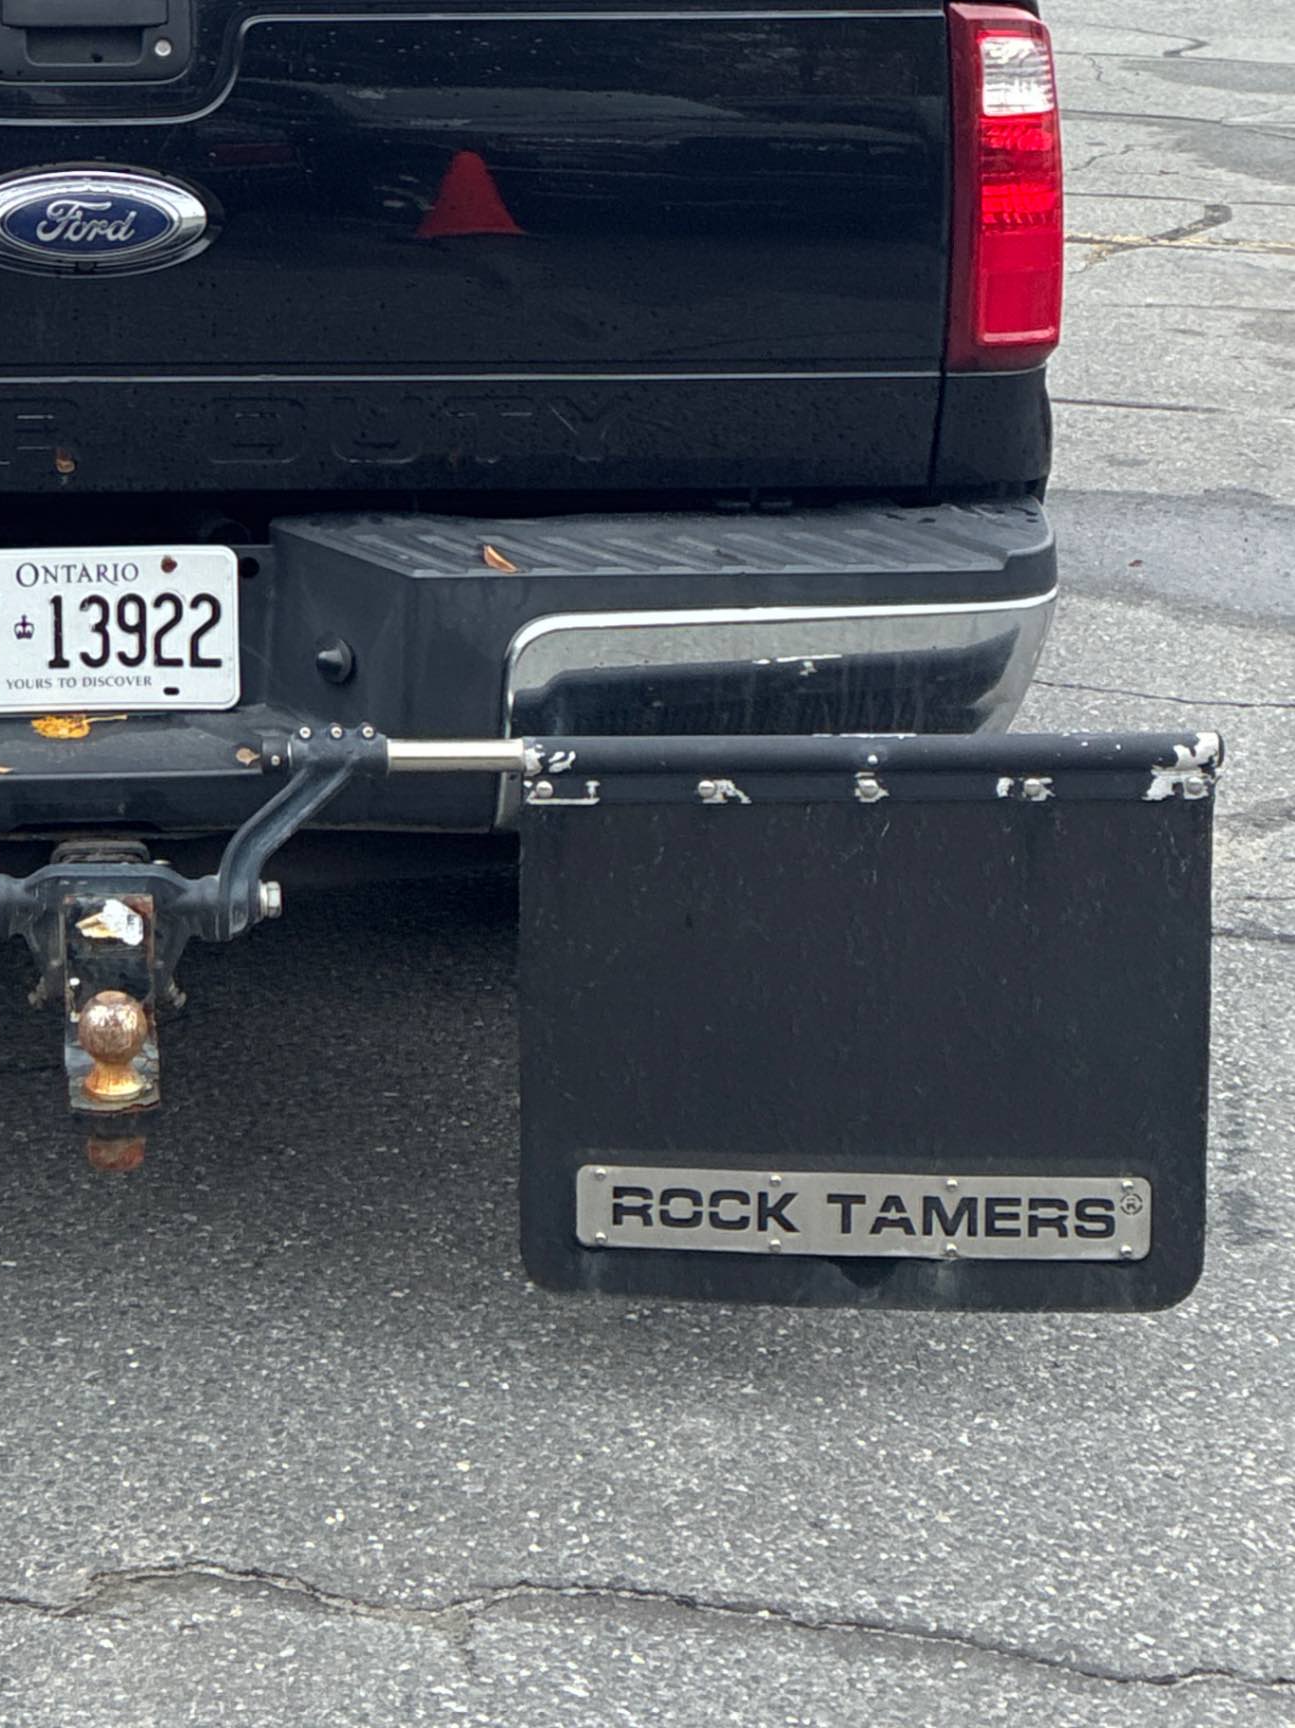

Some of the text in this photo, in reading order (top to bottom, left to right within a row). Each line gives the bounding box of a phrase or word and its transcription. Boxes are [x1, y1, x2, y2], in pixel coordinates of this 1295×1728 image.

[36, 199, 137, 242] Ford
[207, 394, 637, 465] DUTY
[15, 562, 140, 587] ONTARIO
[6, 675, 152, 690] YOURS TO DISCOVER
[612, 1186, 800, 1233] ROCK
